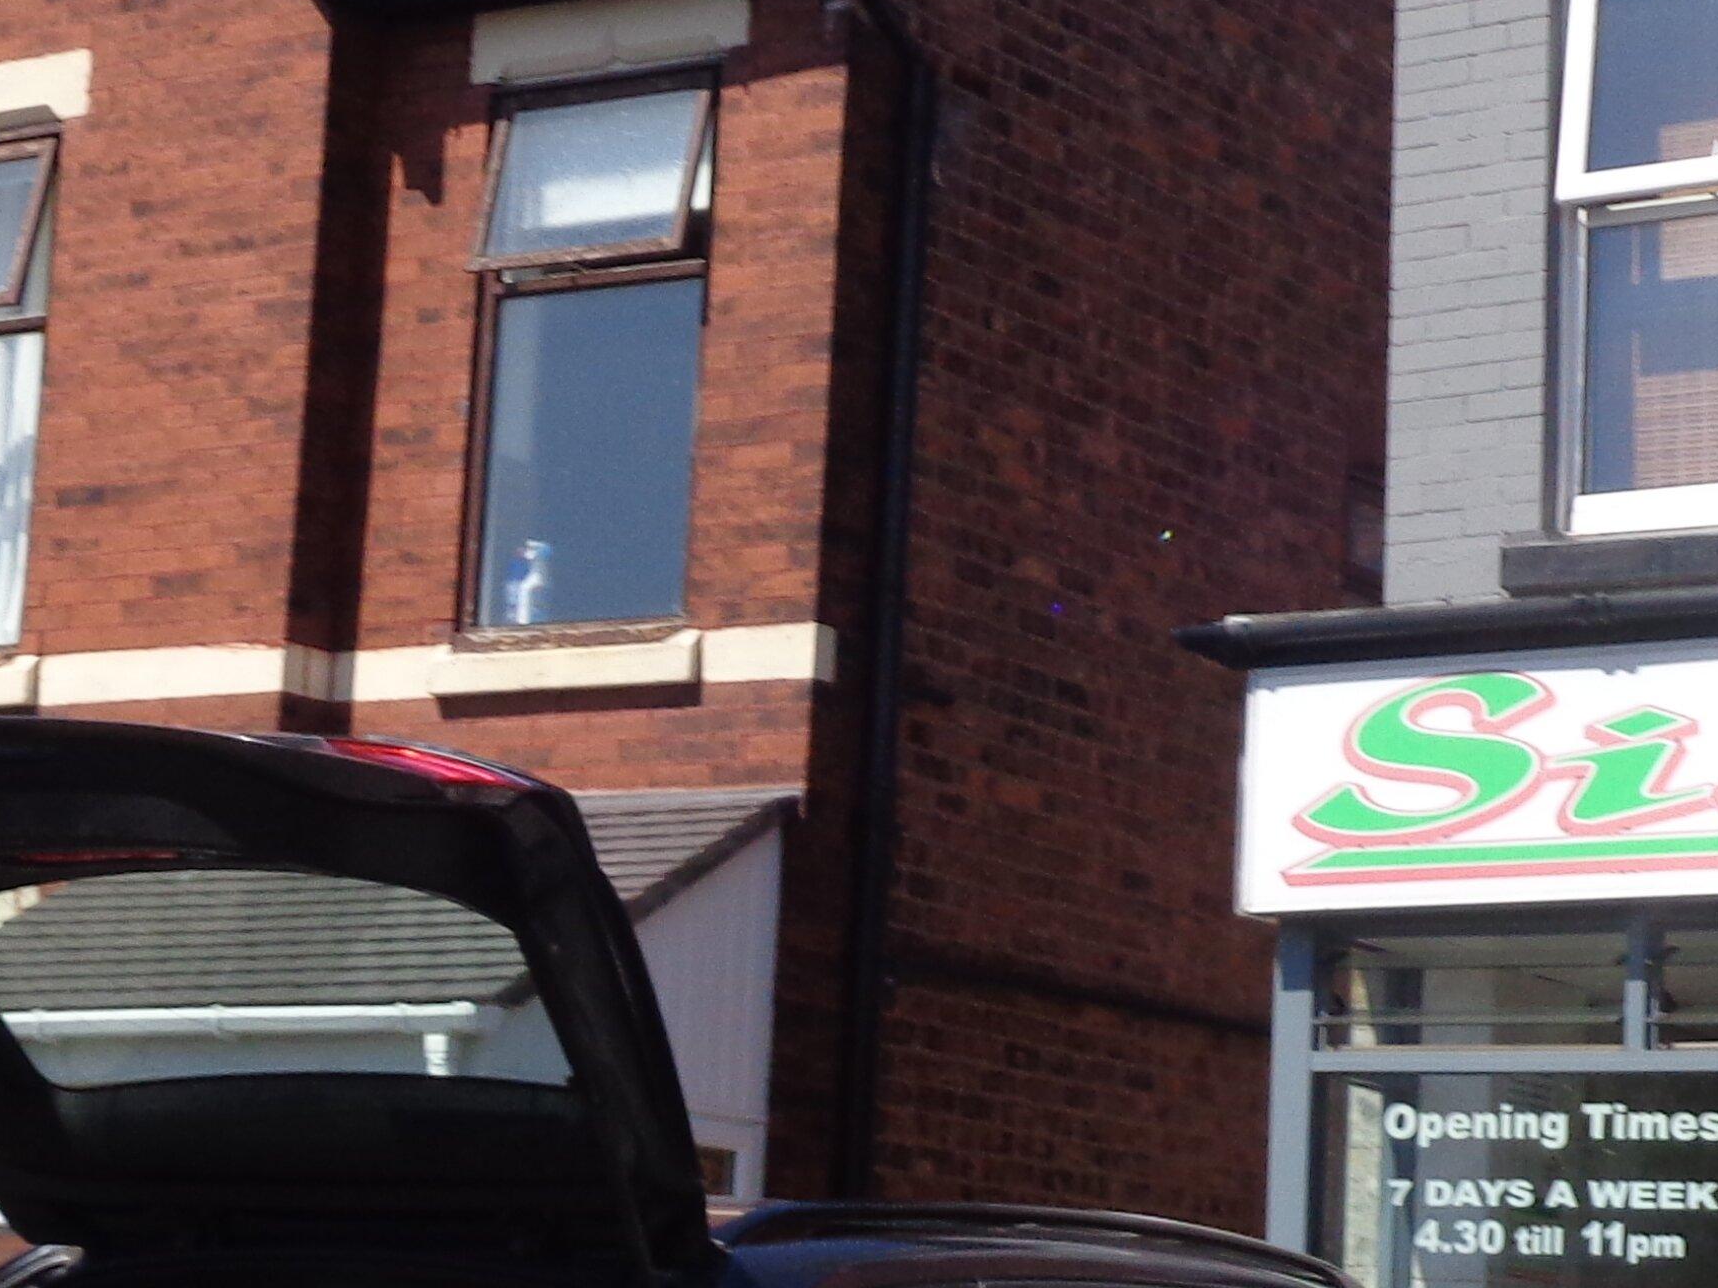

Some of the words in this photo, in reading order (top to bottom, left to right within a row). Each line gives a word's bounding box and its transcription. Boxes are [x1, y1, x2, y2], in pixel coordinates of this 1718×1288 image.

[1383, 1102, 1570, 1150] Opening
[1387, 1178, 1415, 1208] 7
[1423, 1177, 1536, 1209] DAYS
[1543, 1179, 1580, 1209] A
[1413, 1218, 1507, 1256] 4.30
[1512, 1224, 1566, 1257] till
[1580, 1219, 1688, 1266] 11pm
